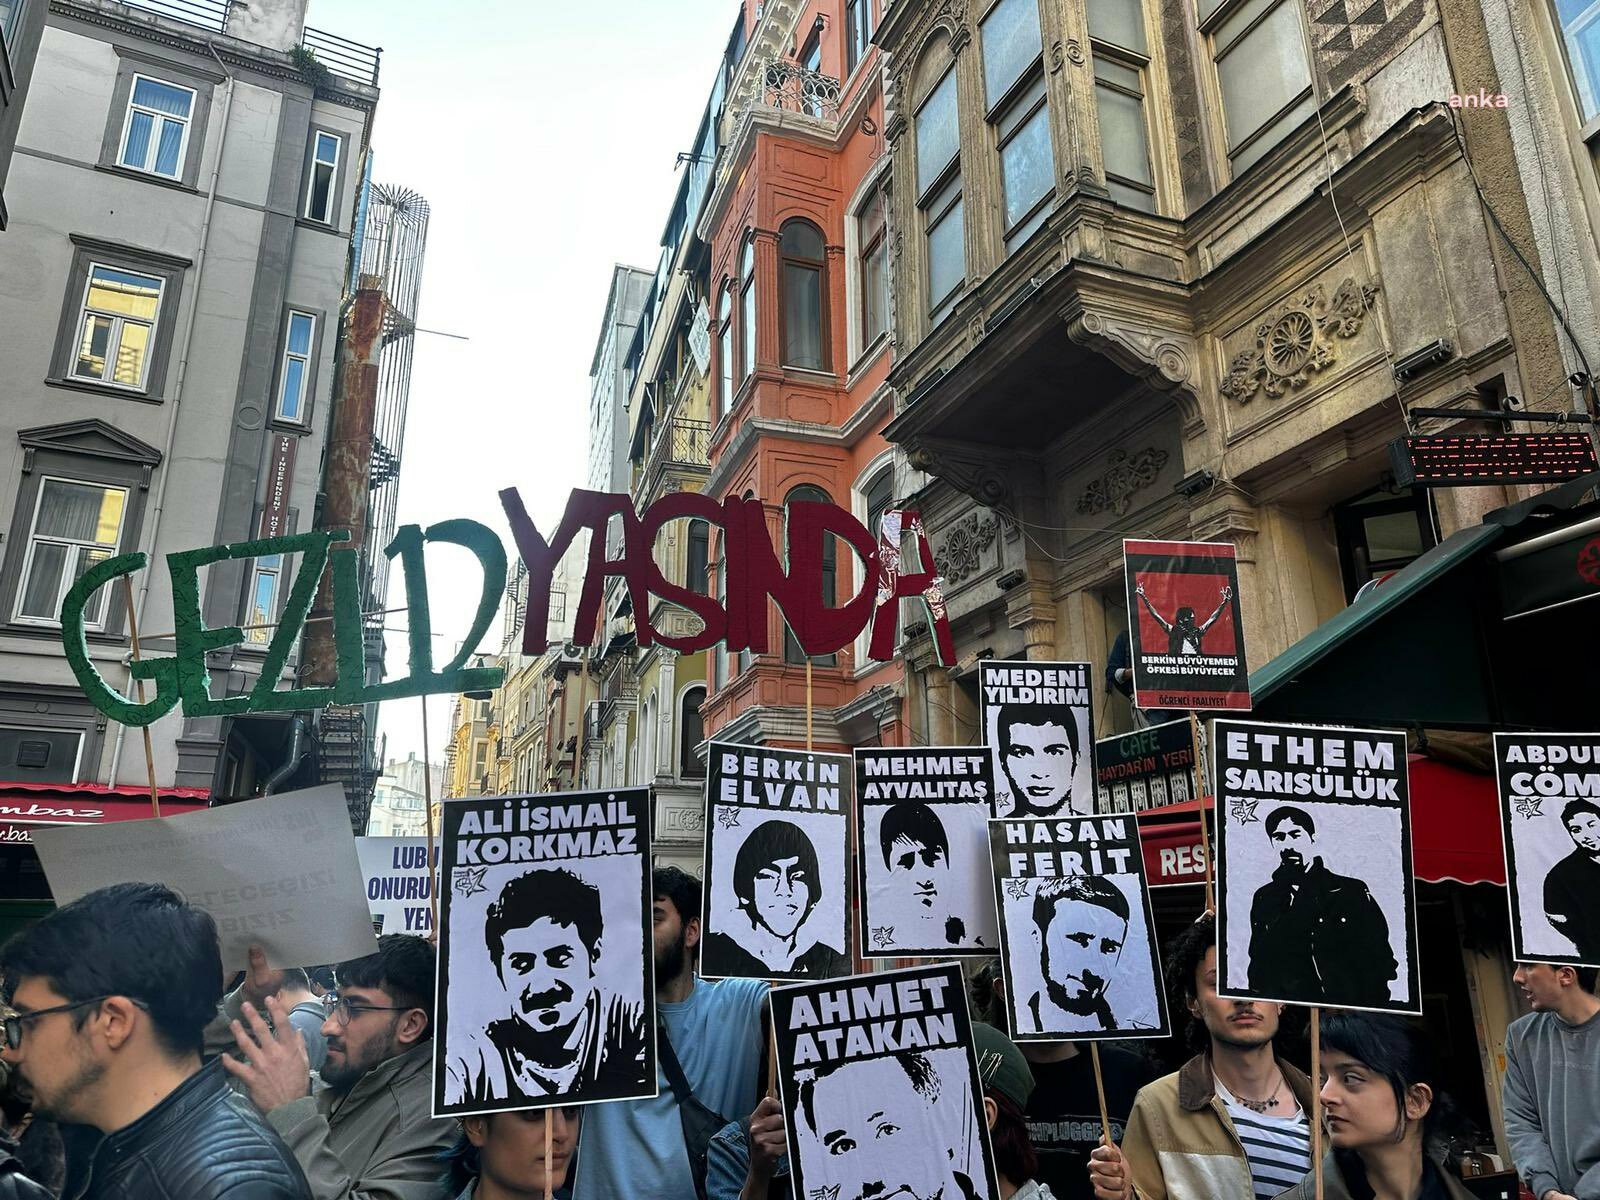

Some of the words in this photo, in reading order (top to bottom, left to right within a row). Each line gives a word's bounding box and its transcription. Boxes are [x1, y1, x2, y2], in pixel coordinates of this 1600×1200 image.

[273, 457, 286, 510] INDEPENDENT
[270, 516, 279, 539] HOTE
[384, 517, 508, 700] 12
[986, 665, 1086, 687] MEDENİ
[1141, 654, 1177, 665] BERKİN
[1177, 655, 1239, 666] BÜYÜYEMEDİ
[1146, 664, 1180, 674] ÖFKESİ
[1181, 665, 1236, 676] BÜYÜYECEK
[984, 686, 1089, 705] YILDIRIM
[1119, 730, 1161, 758] CAFE
[1162, 745, 1194, 767] YERİ
[1226, 731, 1395, 771] ETHEM
[721, 753, 840, 784] BERKİN
[864, 756, 985, 776] MEHMET
[1510, 765, 1600, 797] CÖM
[720, 778, 840, 811] ELVAN
[864, 781, 988, 803] AYVALITAŞ
[1224, 766, 1400, 801] SARISÜLÜK
[457, 800, 513, 835] ALİ
[519, 794, 636, 832] İSMAİL
[456, 828, 637, 865] KORKMAZ
[1006, 819, 1127, 844] HASAN
[1009, 842, 1131, 877] FERİT
[1160, 844, 1208, 877] RES
[789, 975, 950, 1030] AHMET
[793, 1013, 958, 1066] ATAKAN
